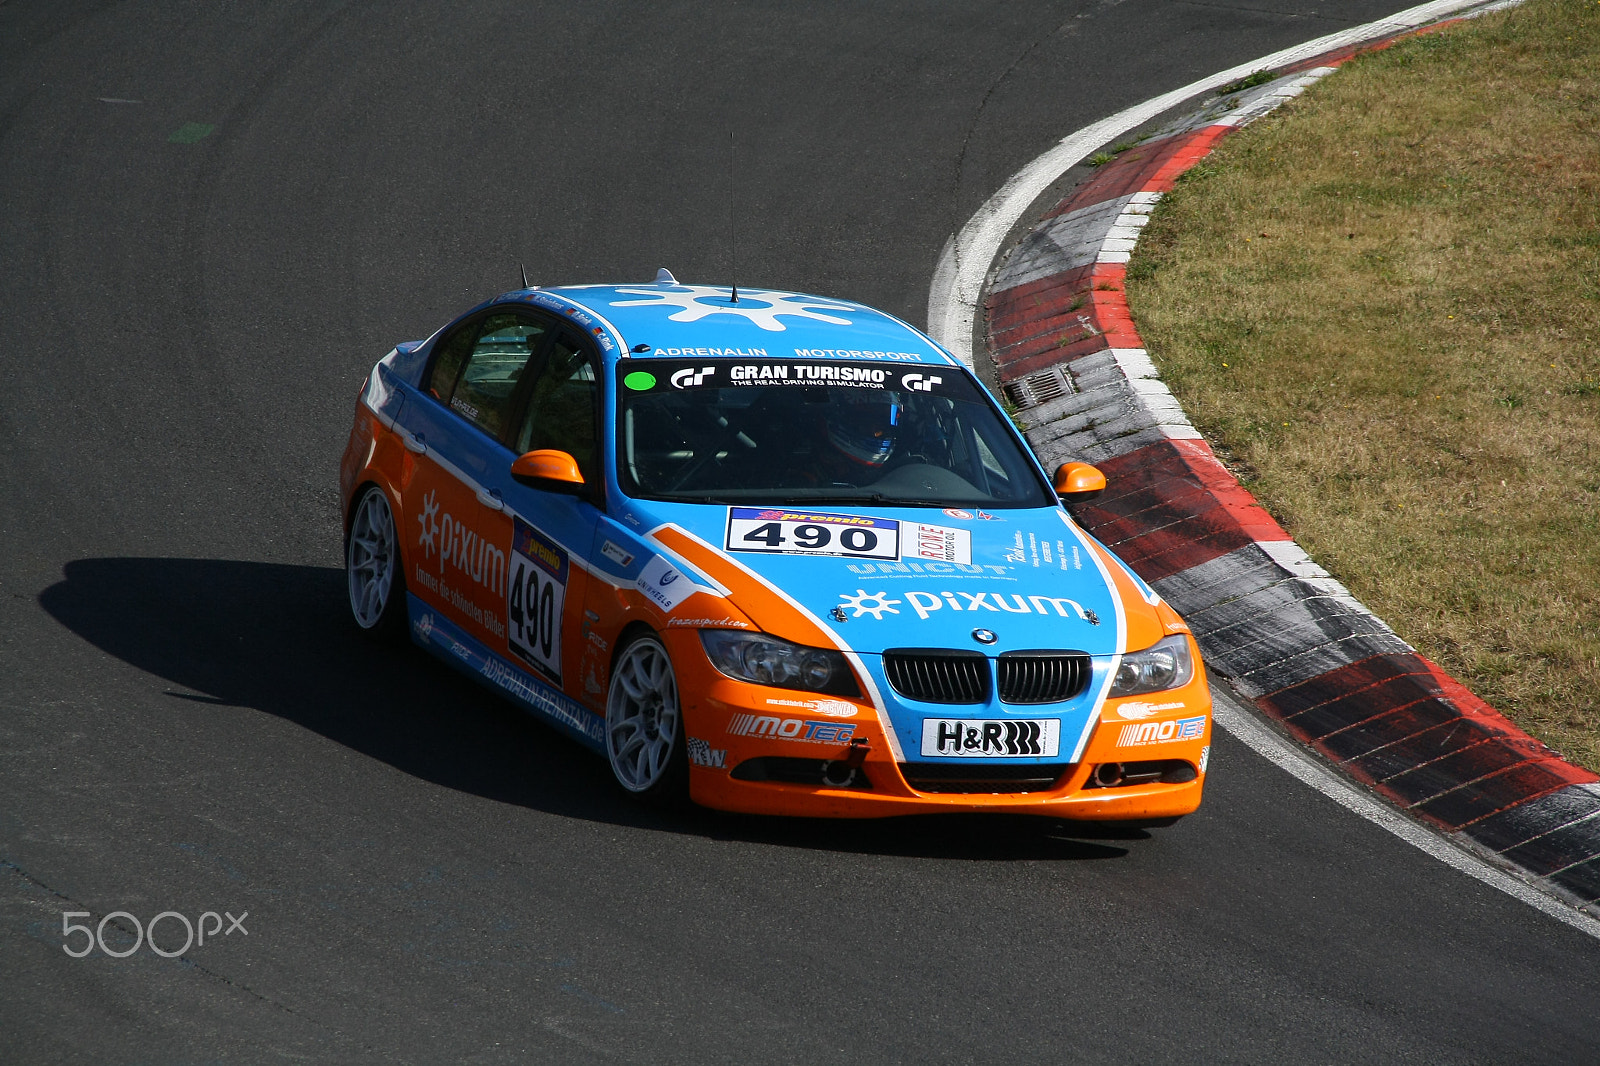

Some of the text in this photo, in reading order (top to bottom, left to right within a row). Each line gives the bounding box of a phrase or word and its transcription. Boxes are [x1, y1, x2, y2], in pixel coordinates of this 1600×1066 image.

[654, 347, 922, 361] ADRENALIN MOTORSPORT
[730, 365, 885, 382] GRAN TURISMO
[827, 380, 885, 389] SIMULATOR
[781, 513, 875, 526] premio
[743, 522, 878, 552] 490
[921, 526, 944, 560] ROWE
[945, 532, 956, 562] MOTOR OIL
[440, 511, 505, 598] pixum
[528, 536, 561, 571] premio
[416, 563, 505, 640] Immer die schönsten Bilder
[637, 579, 672, 608] UNIWHEELS
[904, 591, 1090, 620] pixum
[510, 562, 554, 660] 490
[667, 616, 749, 628] frozenspeed.com
[692, 748, 727, 768] KW
